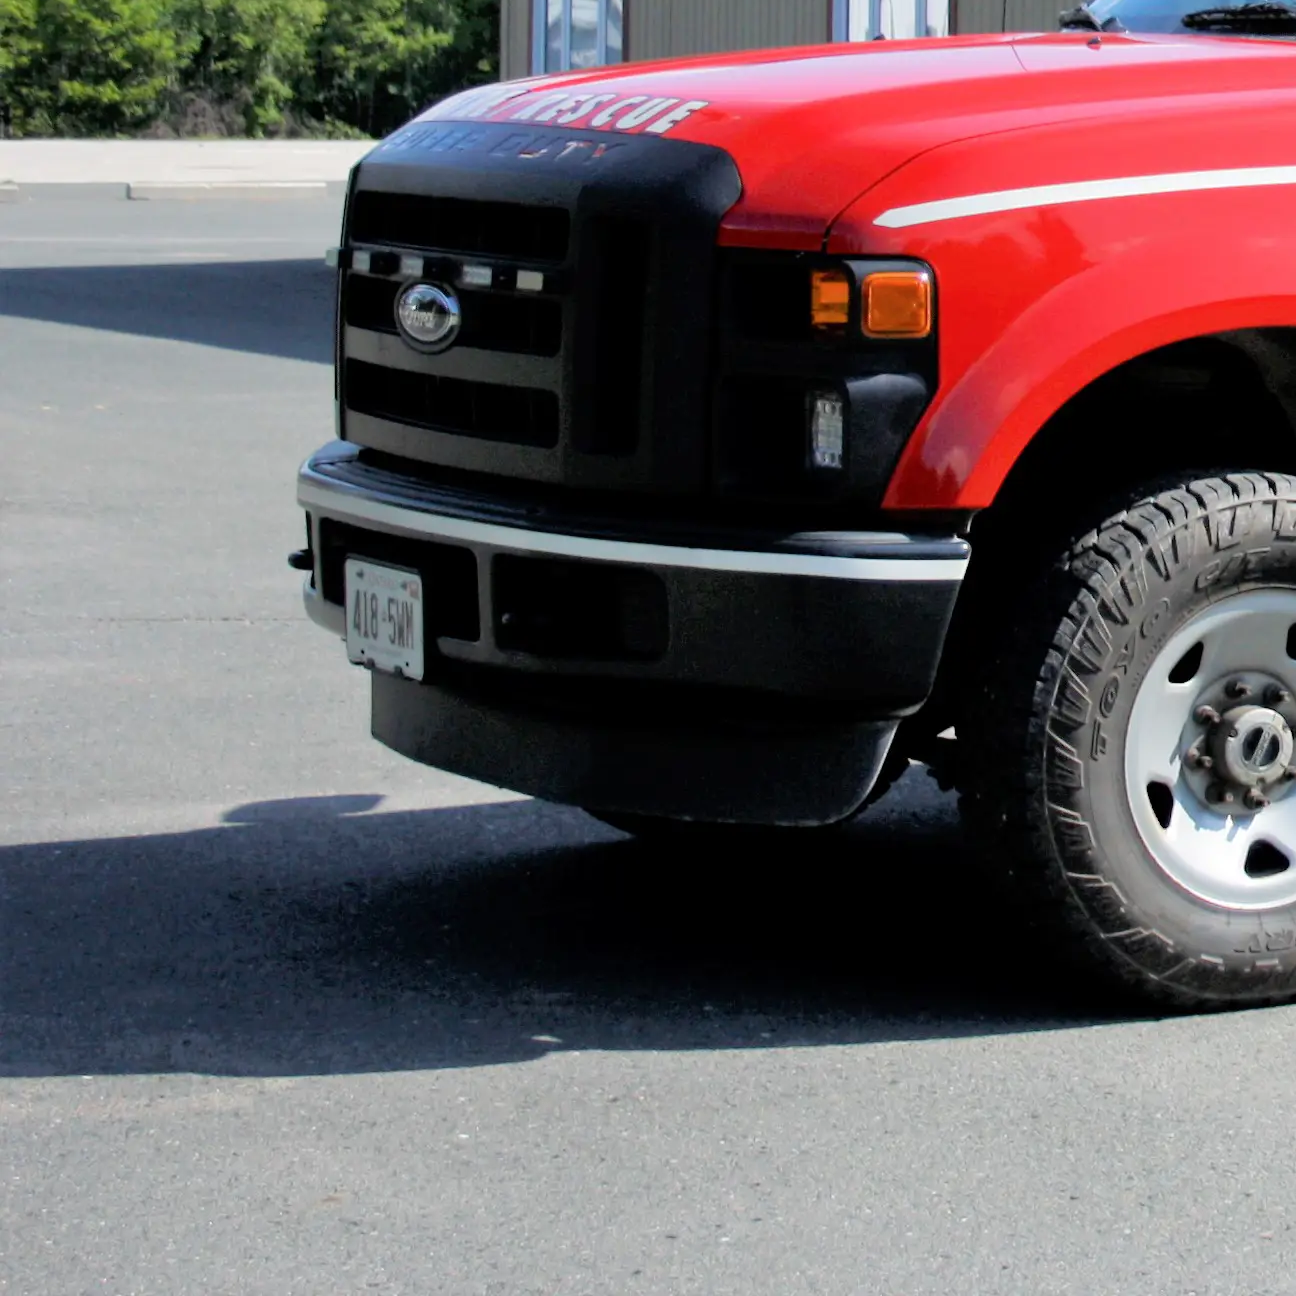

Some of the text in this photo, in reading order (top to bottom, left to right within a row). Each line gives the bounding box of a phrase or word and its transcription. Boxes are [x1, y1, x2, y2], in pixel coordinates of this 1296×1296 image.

[486, 131, 628, 164] DUTY
[353, 588, 379, 642] 418
[1091, 597, 1171, 761] TOYO
